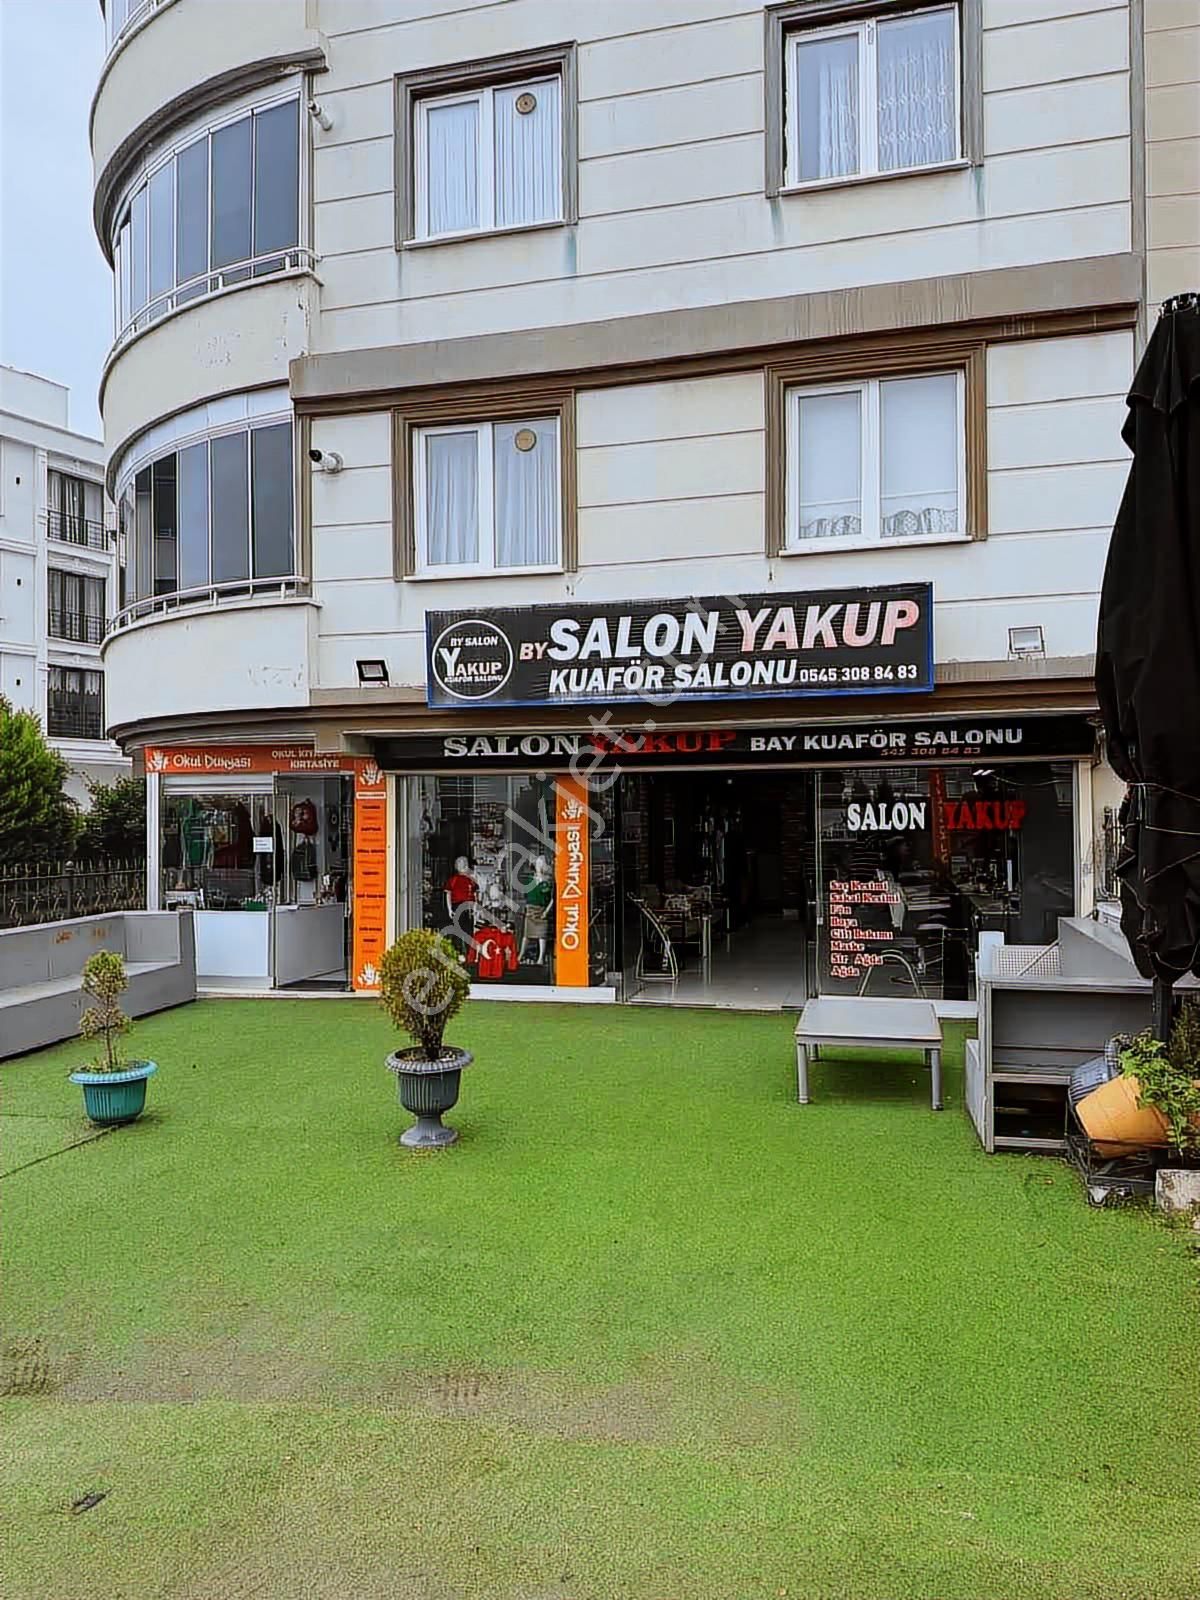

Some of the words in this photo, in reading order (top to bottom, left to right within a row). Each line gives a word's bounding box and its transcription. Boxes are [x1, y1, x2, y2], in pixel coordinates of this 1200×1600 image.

[450, 636, 463, 647] BY
[464, 635, 499, 647] SALON
[519, 641, 548, 661] BY
[547, 610, 720, 661] SALON
[735, 599, 920, 652] YAKUP
[438, 647, 503, 677] YAKUP
[548, 661, 666, 694] KUAFÖR
[672, 658, 798, 690] SALONU
[799, 667, 837, 683] 0545
[841, 665, 870, 681] 308
[874, 664, 893, 681] 84
[897, 663, 918, 679] 83
[443, 735, 581, 757] SALON
[586, 730, 736, 753] YAKUP
[750, 736, 797, 751] BAY
[803, 729, 907, 750] KUAFÖR
[914, 728, 1023, 747] SALONU
[172, 752, 202, 768] Okul
[846, 802, 927, 832] SALON
[942, 800, 1026, 830] YAKUP
[850, 880, 889, 891] Kesimi
[561, 903, 580, 950] Okul
